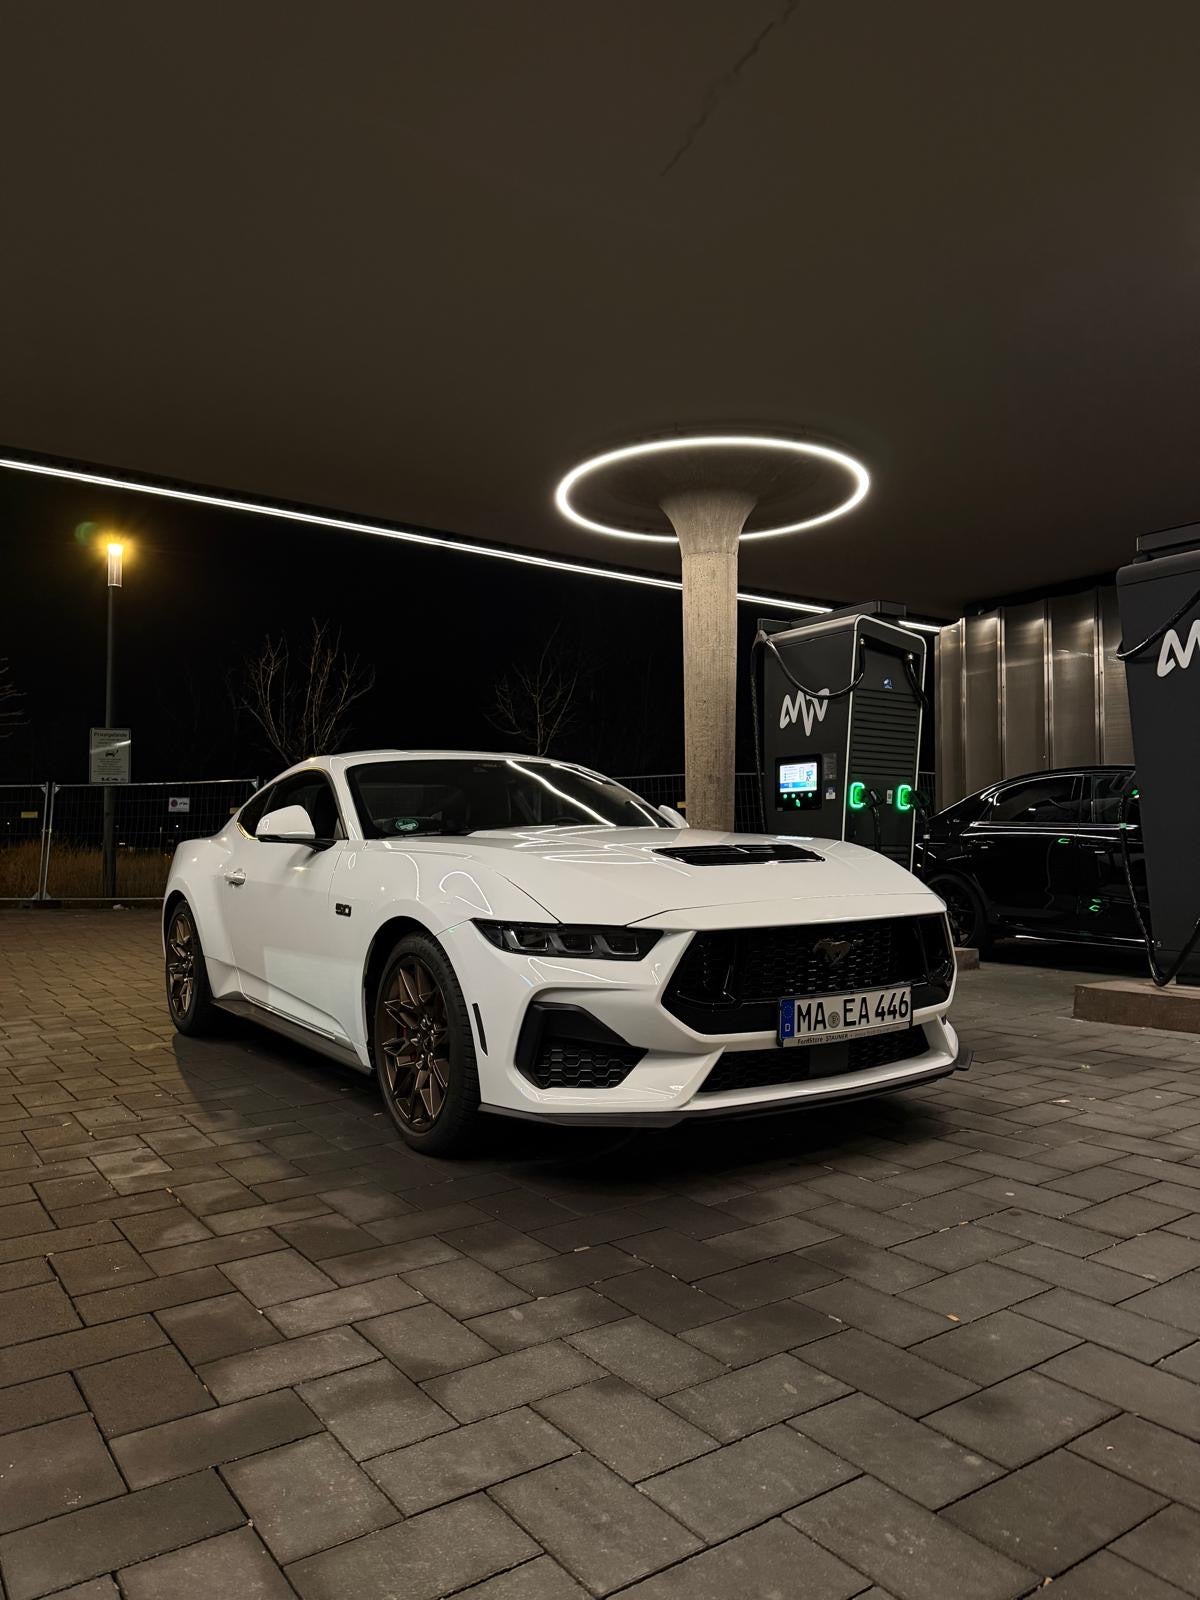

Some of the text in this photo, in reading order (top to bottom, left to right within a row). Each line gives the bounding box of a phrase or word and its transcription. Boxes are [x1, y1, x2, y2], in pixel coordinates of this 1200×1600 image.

[797, 1002, 827, 1032] MA
[843, 997, 870, 1027] EA
[875, 991, 909, 1021] 446
